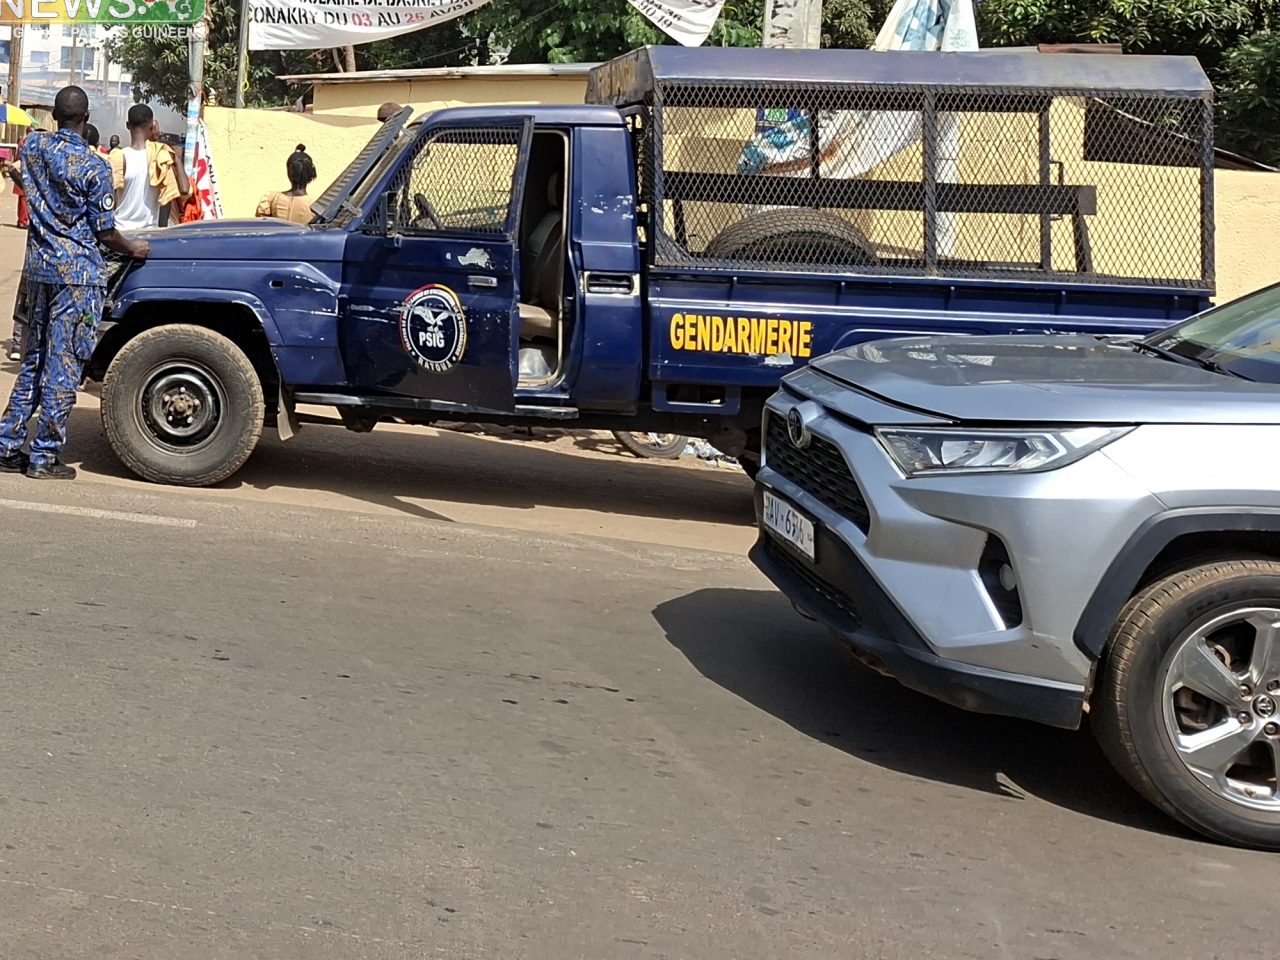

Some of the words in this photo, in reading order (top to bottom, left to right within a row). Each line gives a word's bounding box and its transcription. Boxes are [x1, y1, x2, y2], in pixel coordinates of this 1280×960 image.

[324, 10, 348, 26] DU
[351, 12, 373, 27] 03
[377, 11, 401, 26] AU
[418, 331, 445, 349] PSIG
[670, 313, 813, 358] GENDARMERIE
[418, 356, 453, 372] RATOMA
